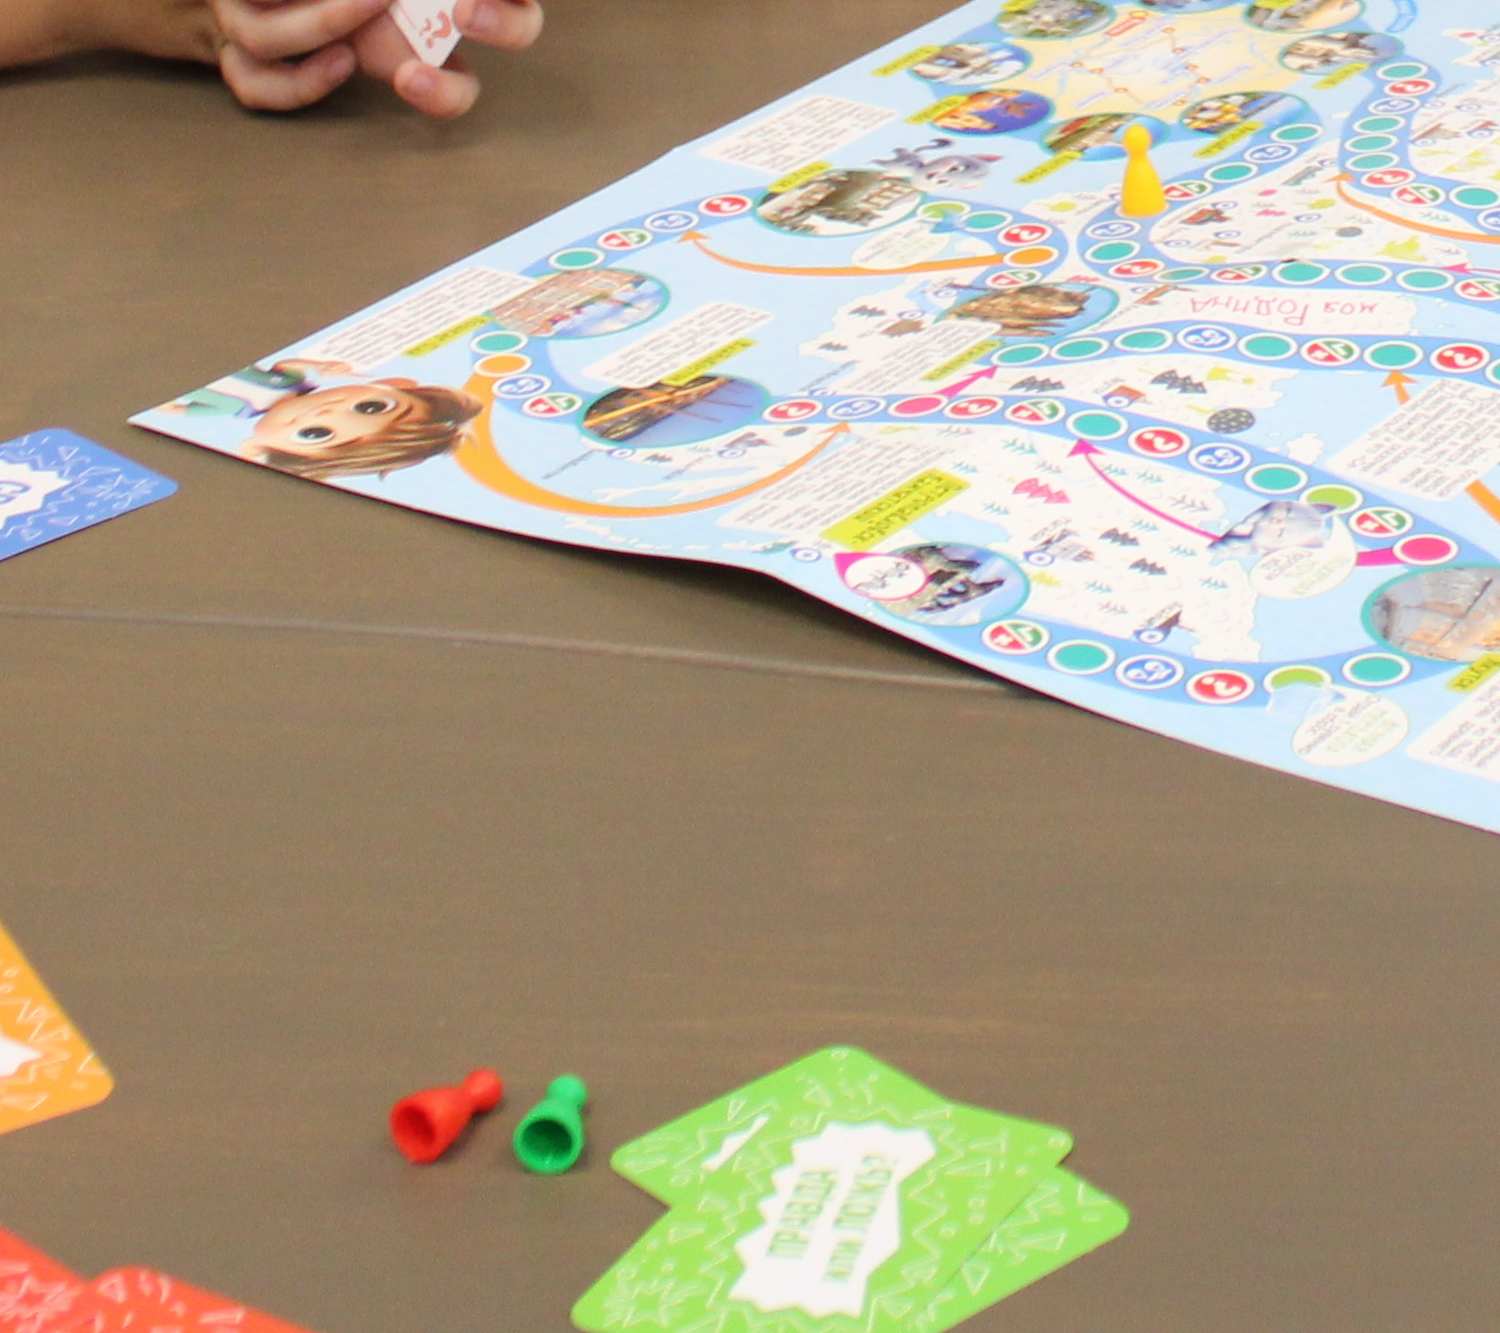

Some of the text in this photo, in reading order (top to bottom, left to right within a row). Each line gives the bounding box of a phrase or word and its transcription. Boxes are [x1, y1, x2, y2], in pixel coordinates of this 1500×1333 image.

[842, 479, 965, 547] Петропавловск-
[848, 472, 946, 525] Камчатский
[765, 1169, 838, 1258] ПРАВДА
